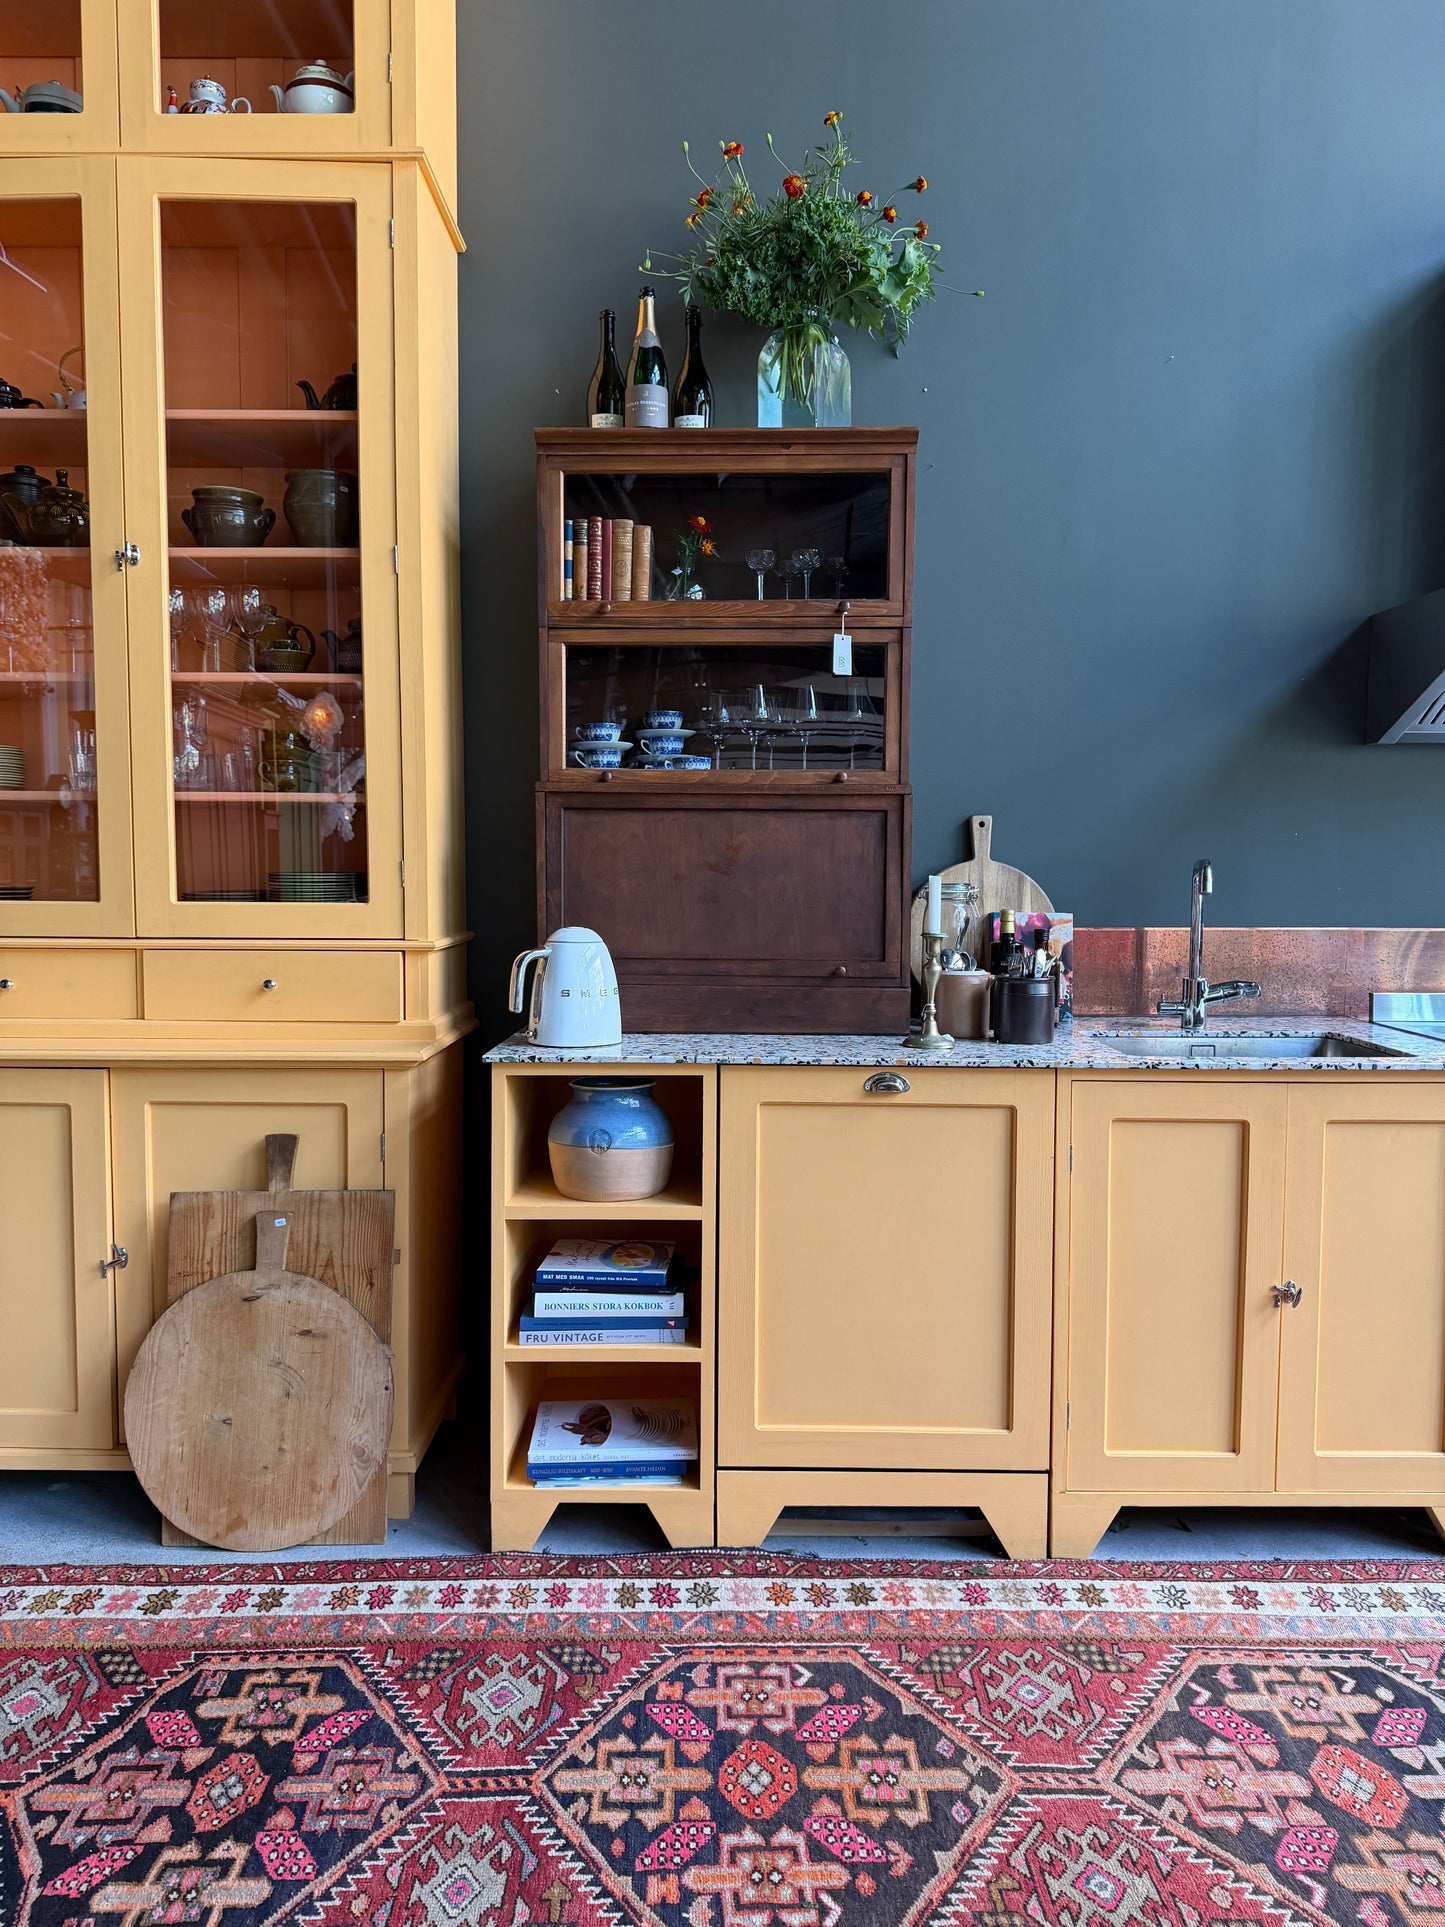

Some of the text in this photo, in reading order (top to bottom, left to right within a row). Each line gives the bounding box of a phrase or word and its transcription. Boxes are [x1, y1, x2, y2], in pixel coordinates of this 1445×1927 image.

[526, 1332, 604, 1343] FRU VINTAGE
[549, 1453, 577, 1461] moderna
